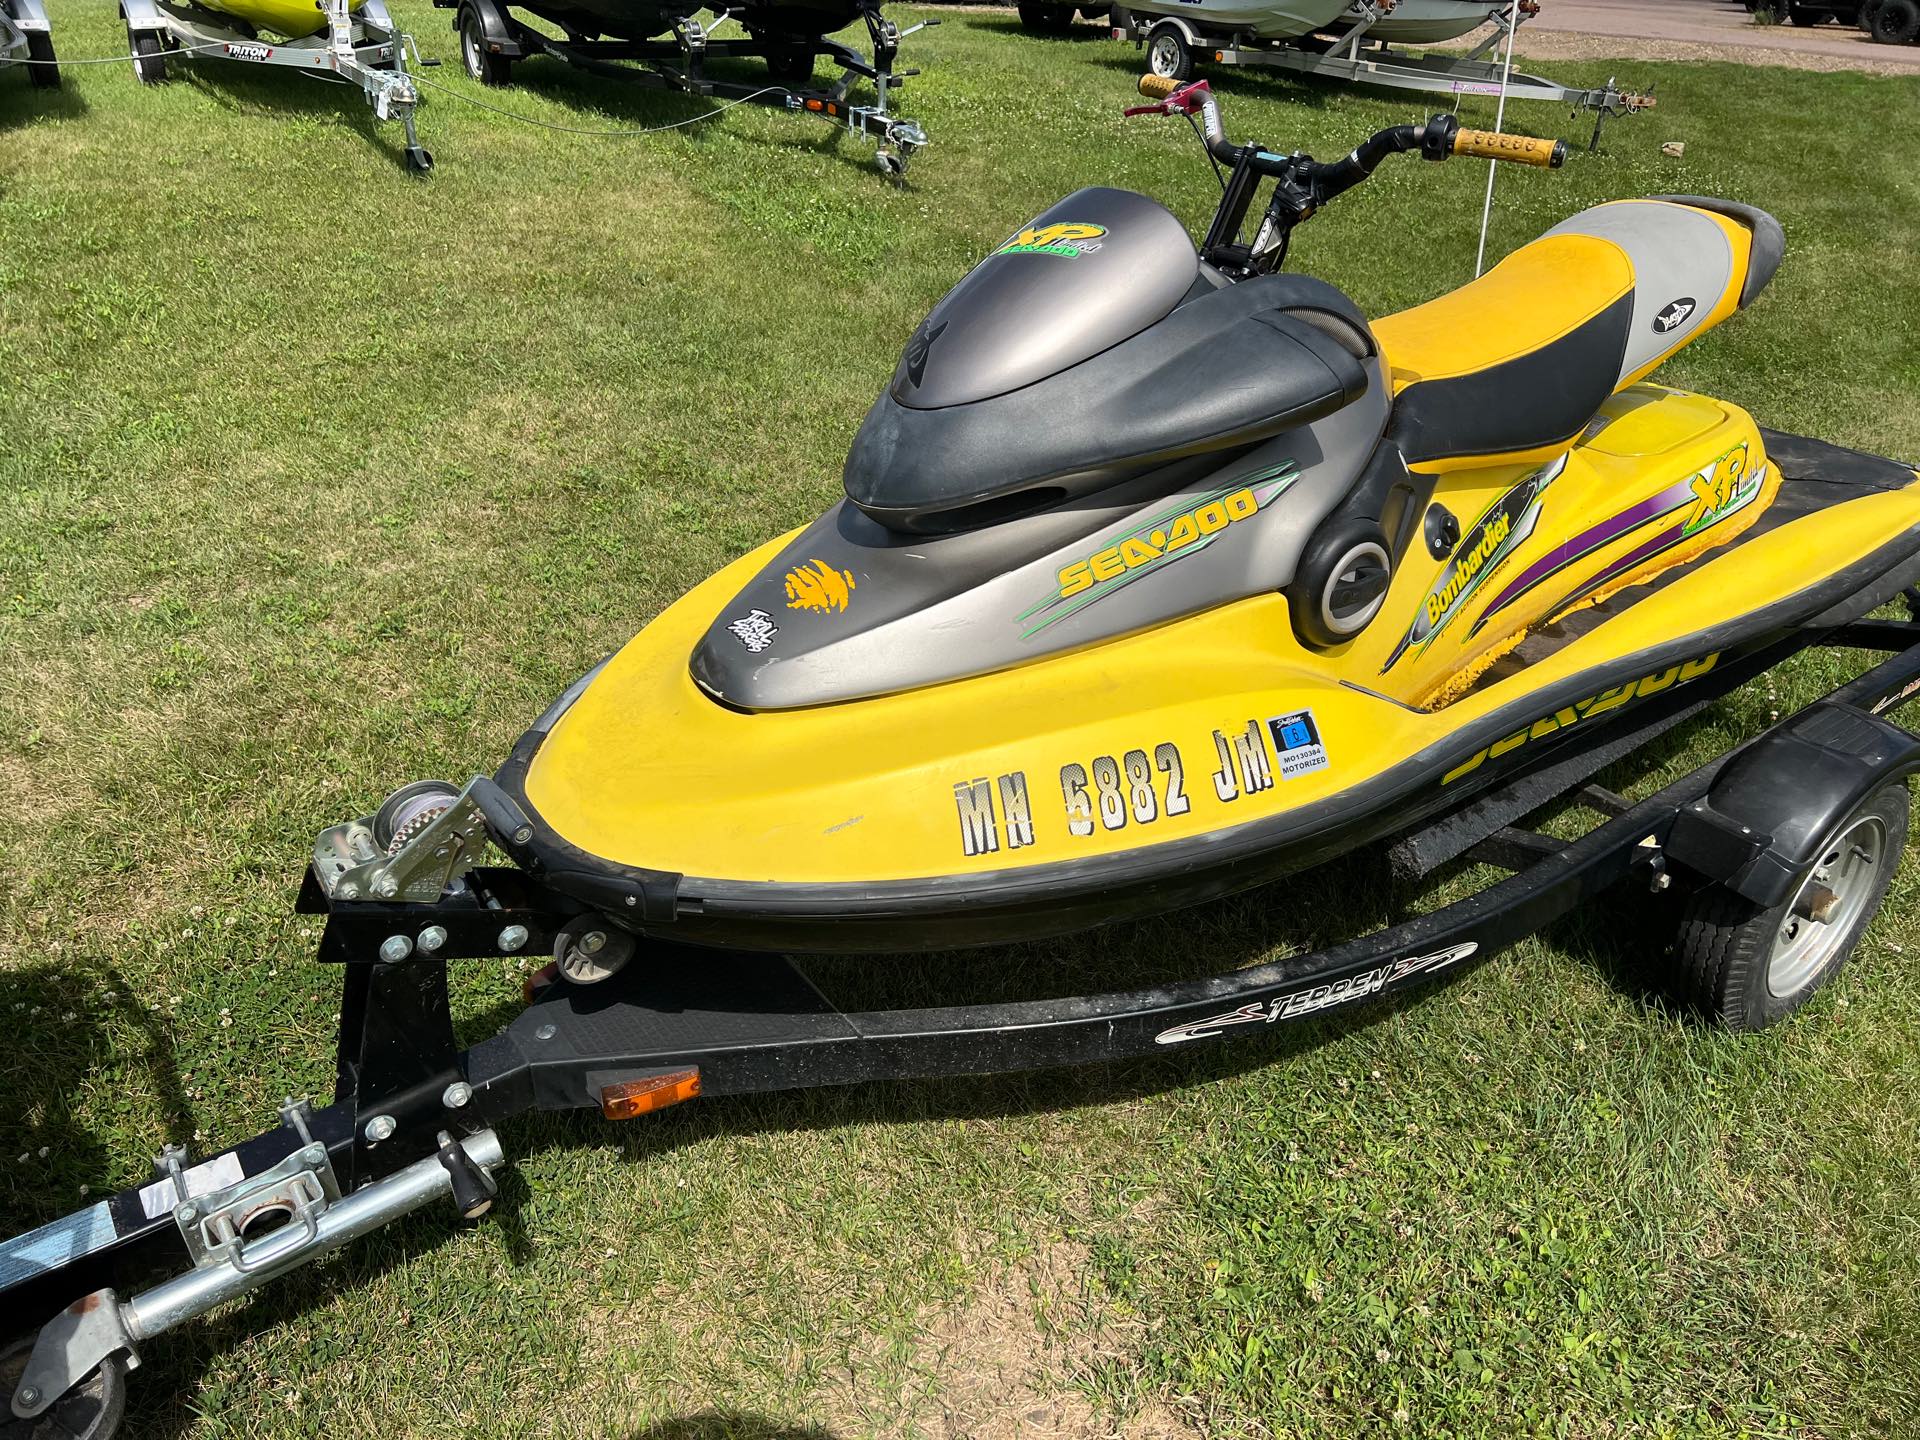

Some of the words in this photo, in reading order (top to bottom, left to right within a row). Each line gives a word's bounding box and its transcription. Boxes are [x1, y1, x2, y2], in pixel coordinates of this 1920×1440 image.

[228, 44, 269, 58] TRITON
[993, 223, 1106, 254] XP
[1684, 446, 1747, 531] XP
[1426, 511, 1511, 629] Bombardier
[1479, 558, 1511, 593] SUSPENSION
[953, 770, 1035, 856] MN
[1060, 743, 1190, 836] 6882
[1212, 719, 1275, 802] JM
[1282, 756, 1326, 775] MOTORIZED
[1265, 963, 1392, 1023] TEBBEN
